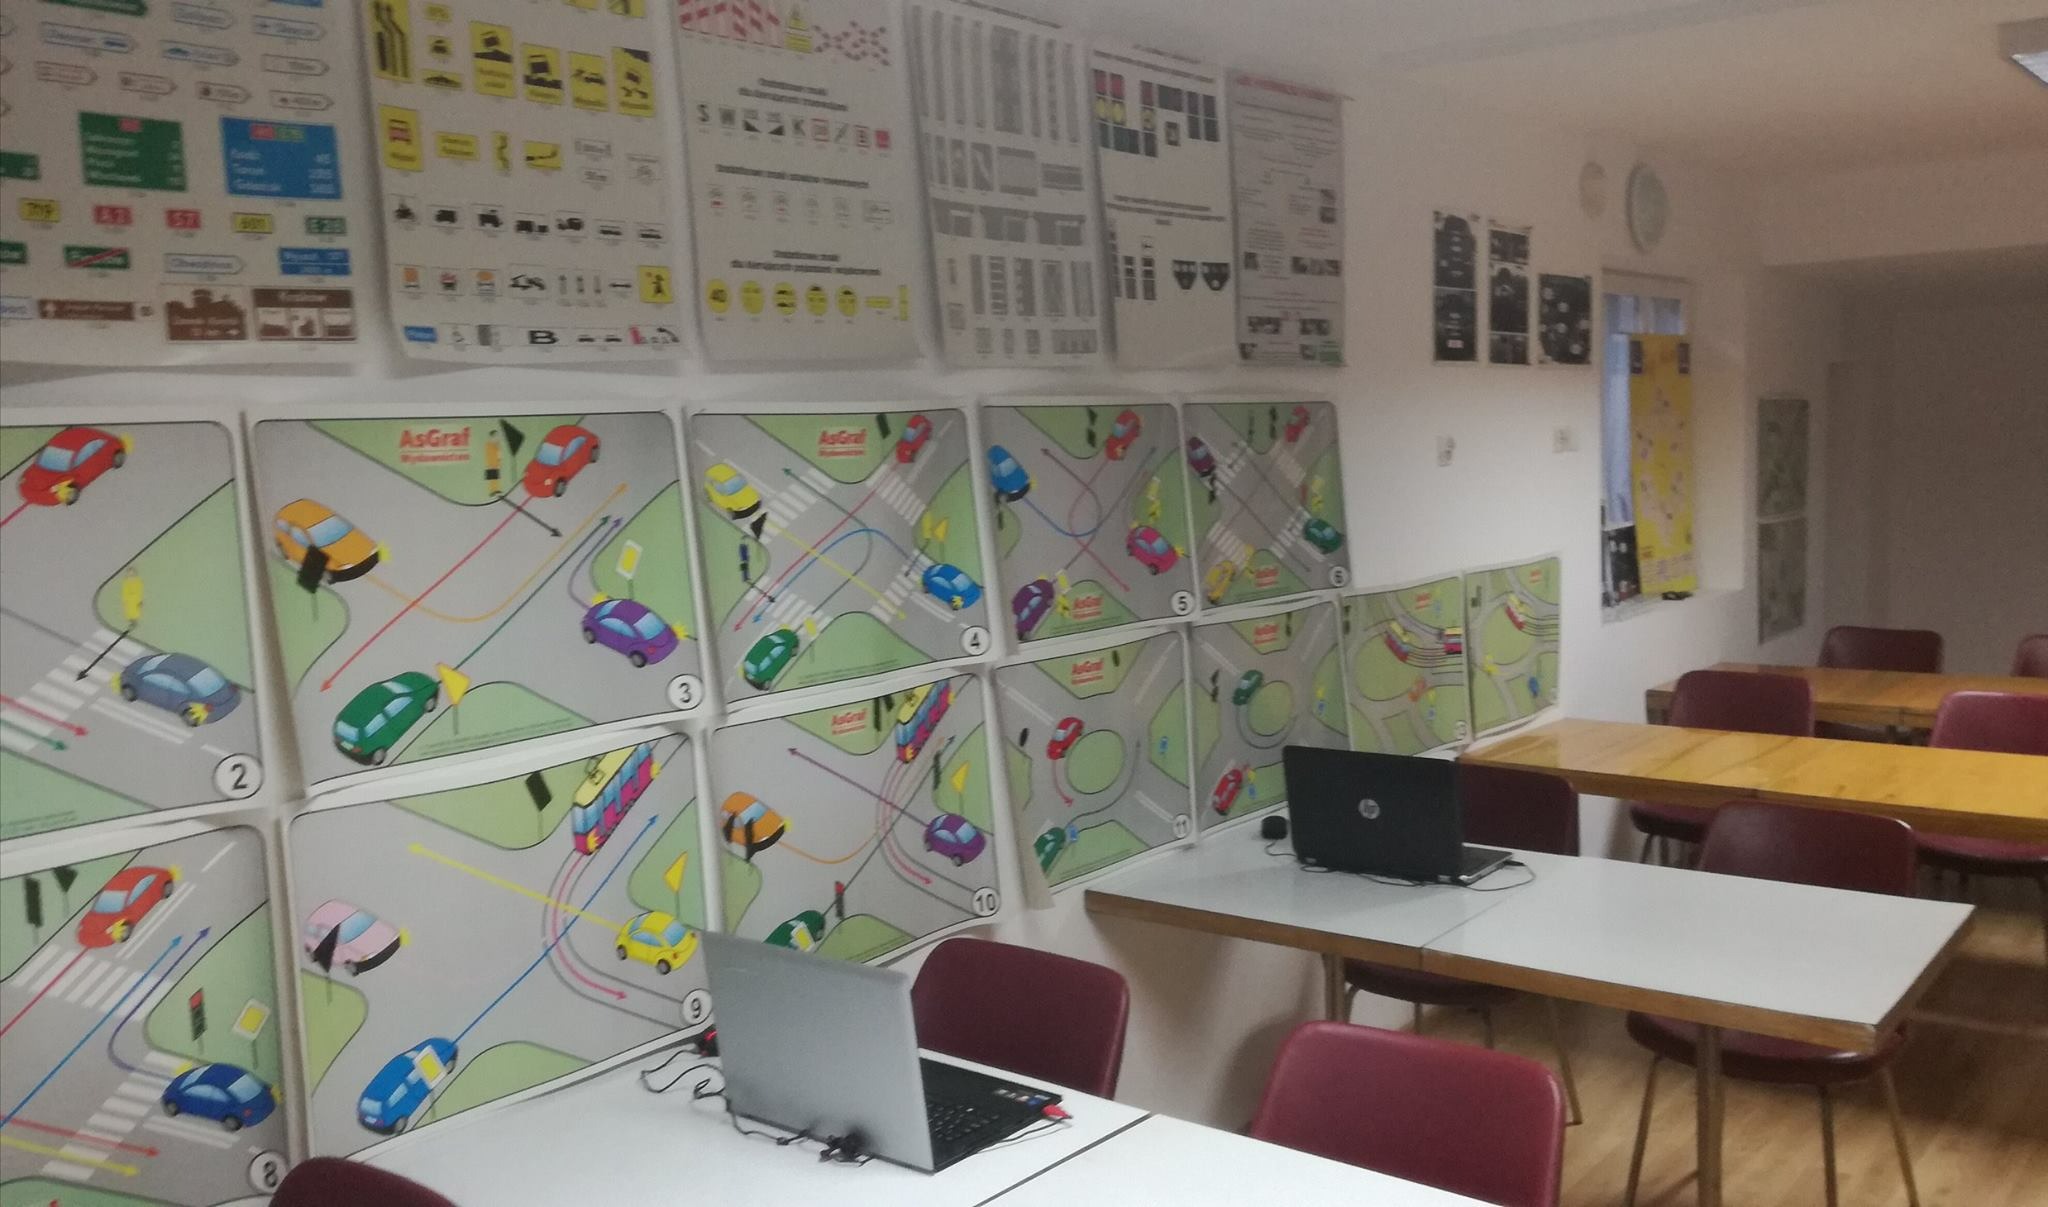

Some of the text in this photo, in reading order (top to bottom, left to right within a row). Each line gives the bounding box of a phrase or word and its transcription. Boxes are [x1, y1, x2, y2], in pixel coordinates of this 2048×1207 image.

[400, 426, 469, 448] AsGraf
[819, 428, 867, 444] AsGraf
[1178, 596, 1188, 611] 5
[970, 632, 981, 649] 4
[679, 682, 692, 704] 3
[232, 763, 248, 790] 2
[975, 893, 996, 913] 10
[691, 997, 702, 1019] 9
[263, 1160, 278, 1188] 8
